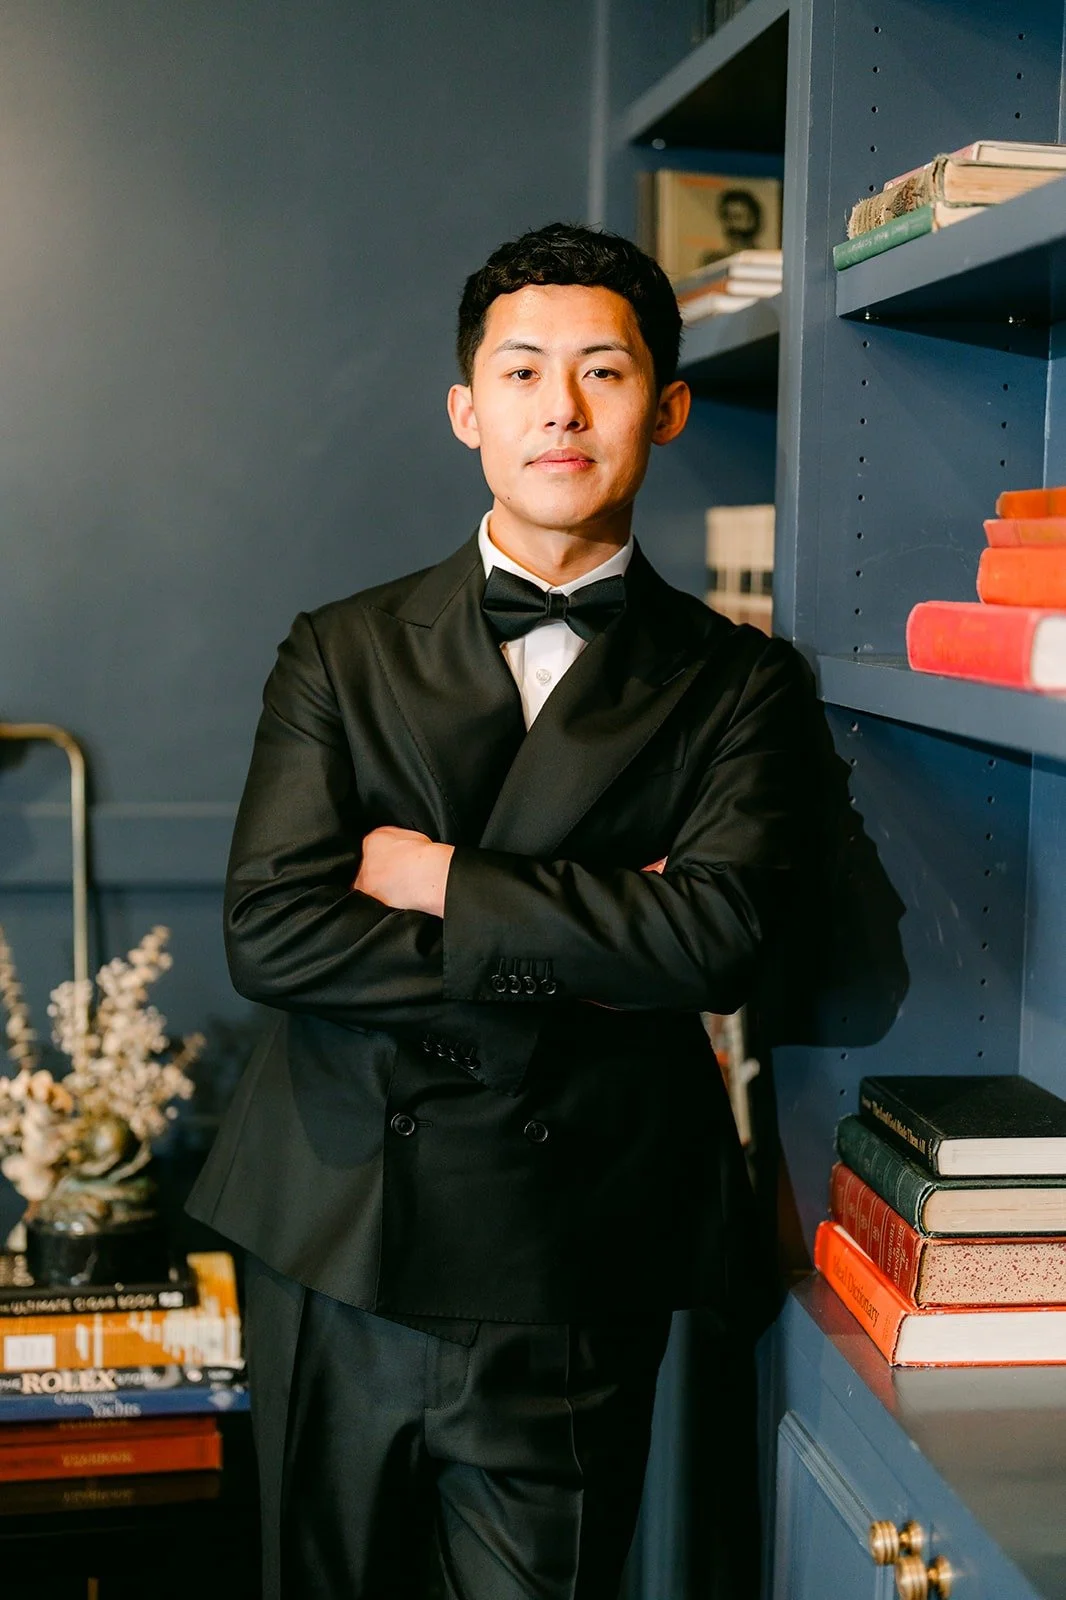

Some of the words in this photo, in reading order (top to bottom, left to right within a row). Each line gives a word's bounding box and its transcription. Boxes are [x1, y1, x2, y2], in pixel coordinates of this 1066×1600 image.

[886, 1223, 896, 1274] THOUGHTS
[893, 1225, 904, 1287] DICTIONARY
[11, 1299, 71, 1315] ULTIMATE
[73, 1297, 115, 1311] CIGAR
[117, 1294, 156, 1310] BOOK
[848, 1271, 880, 1329] Dictionary
[21, 1369, 117, 1394] ROLEX
[91, 1399, 142, 1418] Yachts
